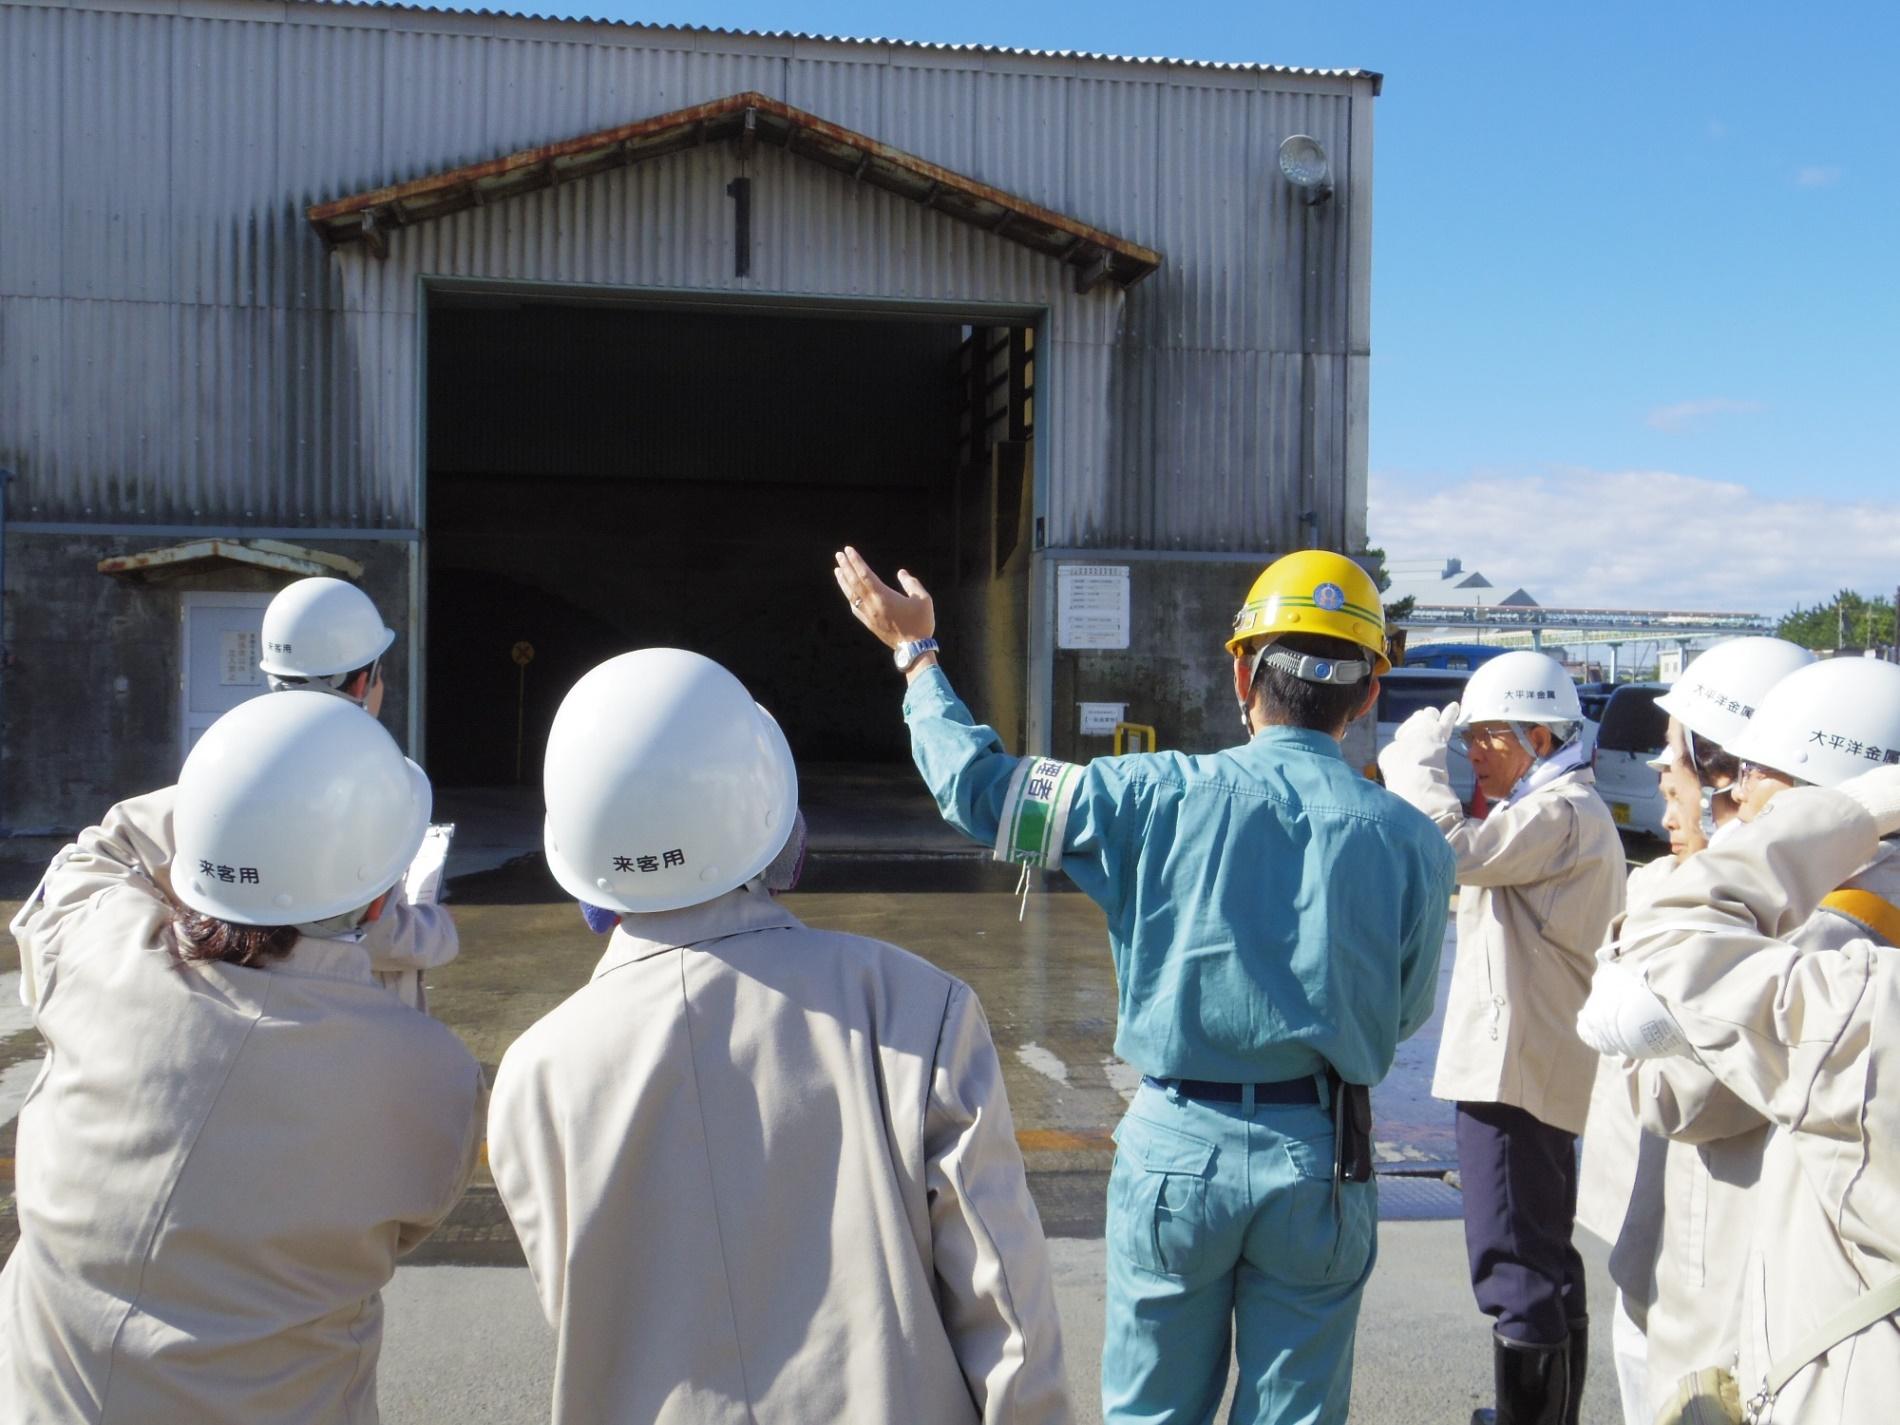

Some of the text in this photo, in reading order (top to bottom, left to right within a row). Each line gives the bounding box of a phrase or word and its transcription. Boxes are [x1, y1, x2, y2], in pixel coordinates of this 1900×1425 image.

[727, 178, 750, 278] 1
[1503, 689, 1556, 700] 大平洋金属
[1028, 758, 1064, 800] 理者
[200, 859, 259, 884] 来客用
[612, 848, 685, 873] 来客用
